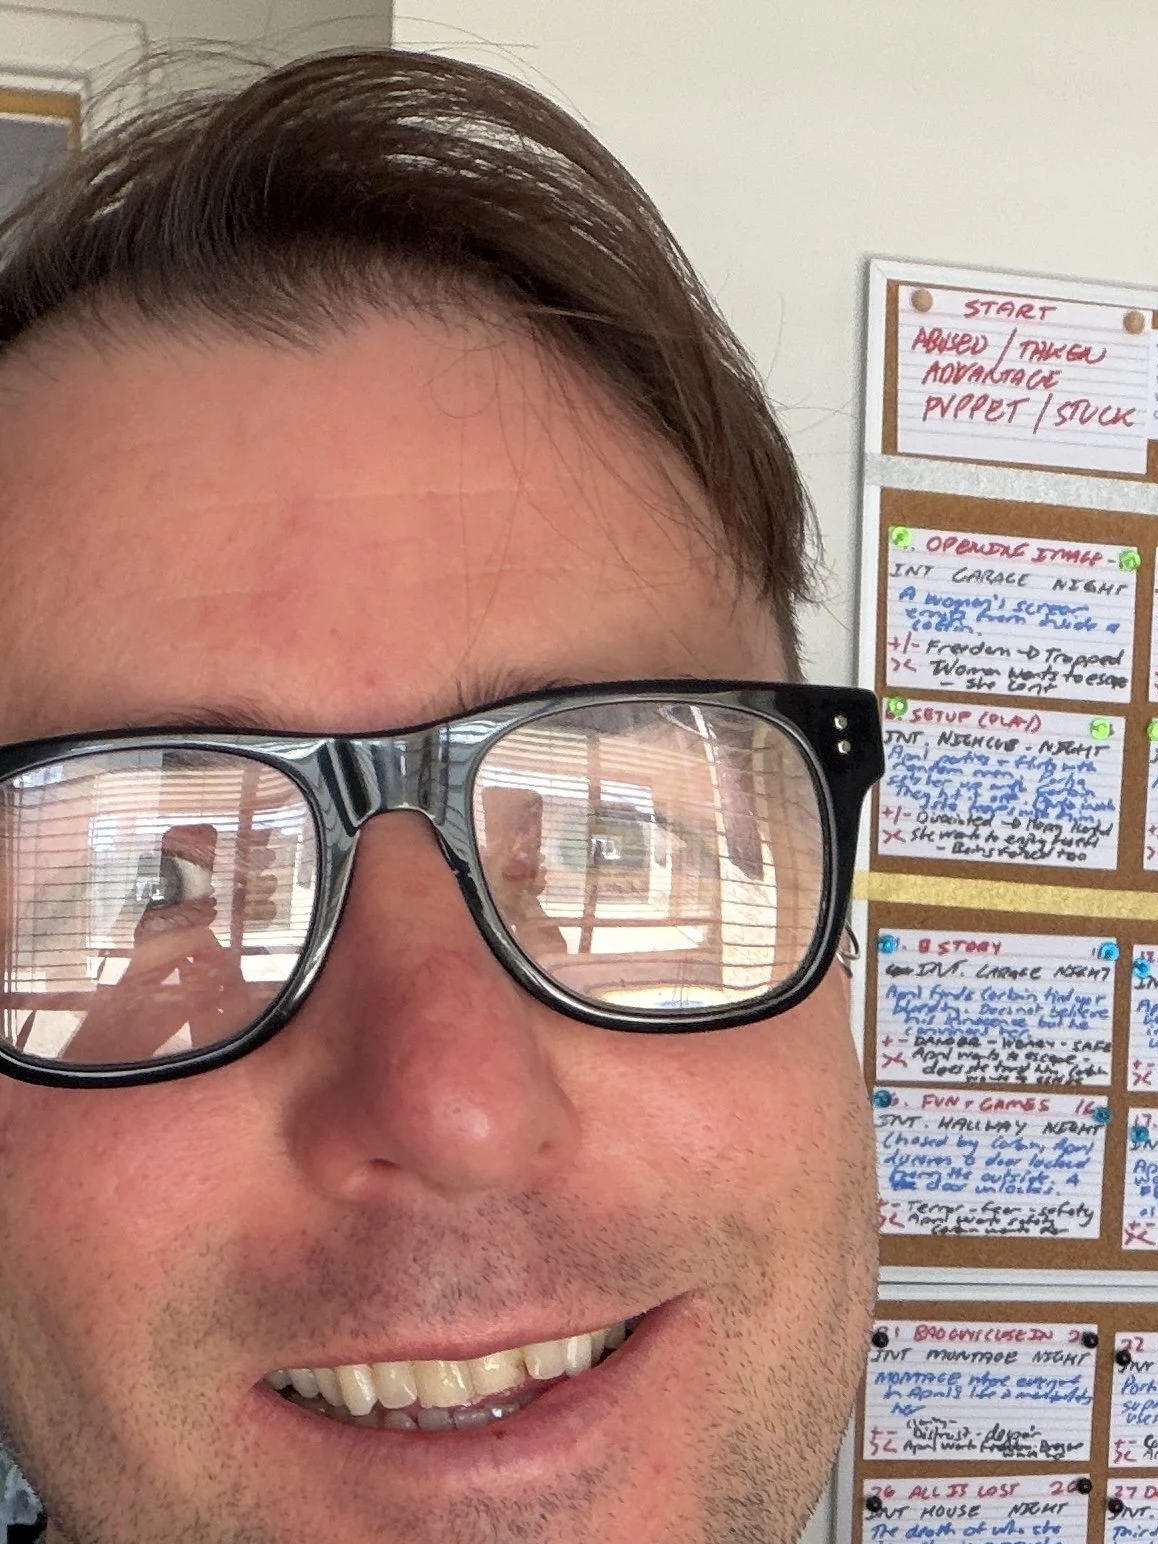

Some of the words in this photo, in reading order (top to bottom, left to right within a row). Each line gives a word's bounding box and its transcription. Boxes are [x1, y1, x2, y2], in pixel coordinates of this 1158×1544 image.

[964, 300, 1057, 320] START
[911, 327, 988, 355] ABUSED
[921, 360, 1062, 390] ADVANTAGE
[922, 394, 1030, 424] PUPPET
[1054, 399, 1136, 427] STUCK
[911, 708, 972, 725] SETUP
[909, 1485, 941, 1500] ALL
[977, 1483, 1020, 1498] LOST
[920, 1505, 981, 1520] HOUSE
